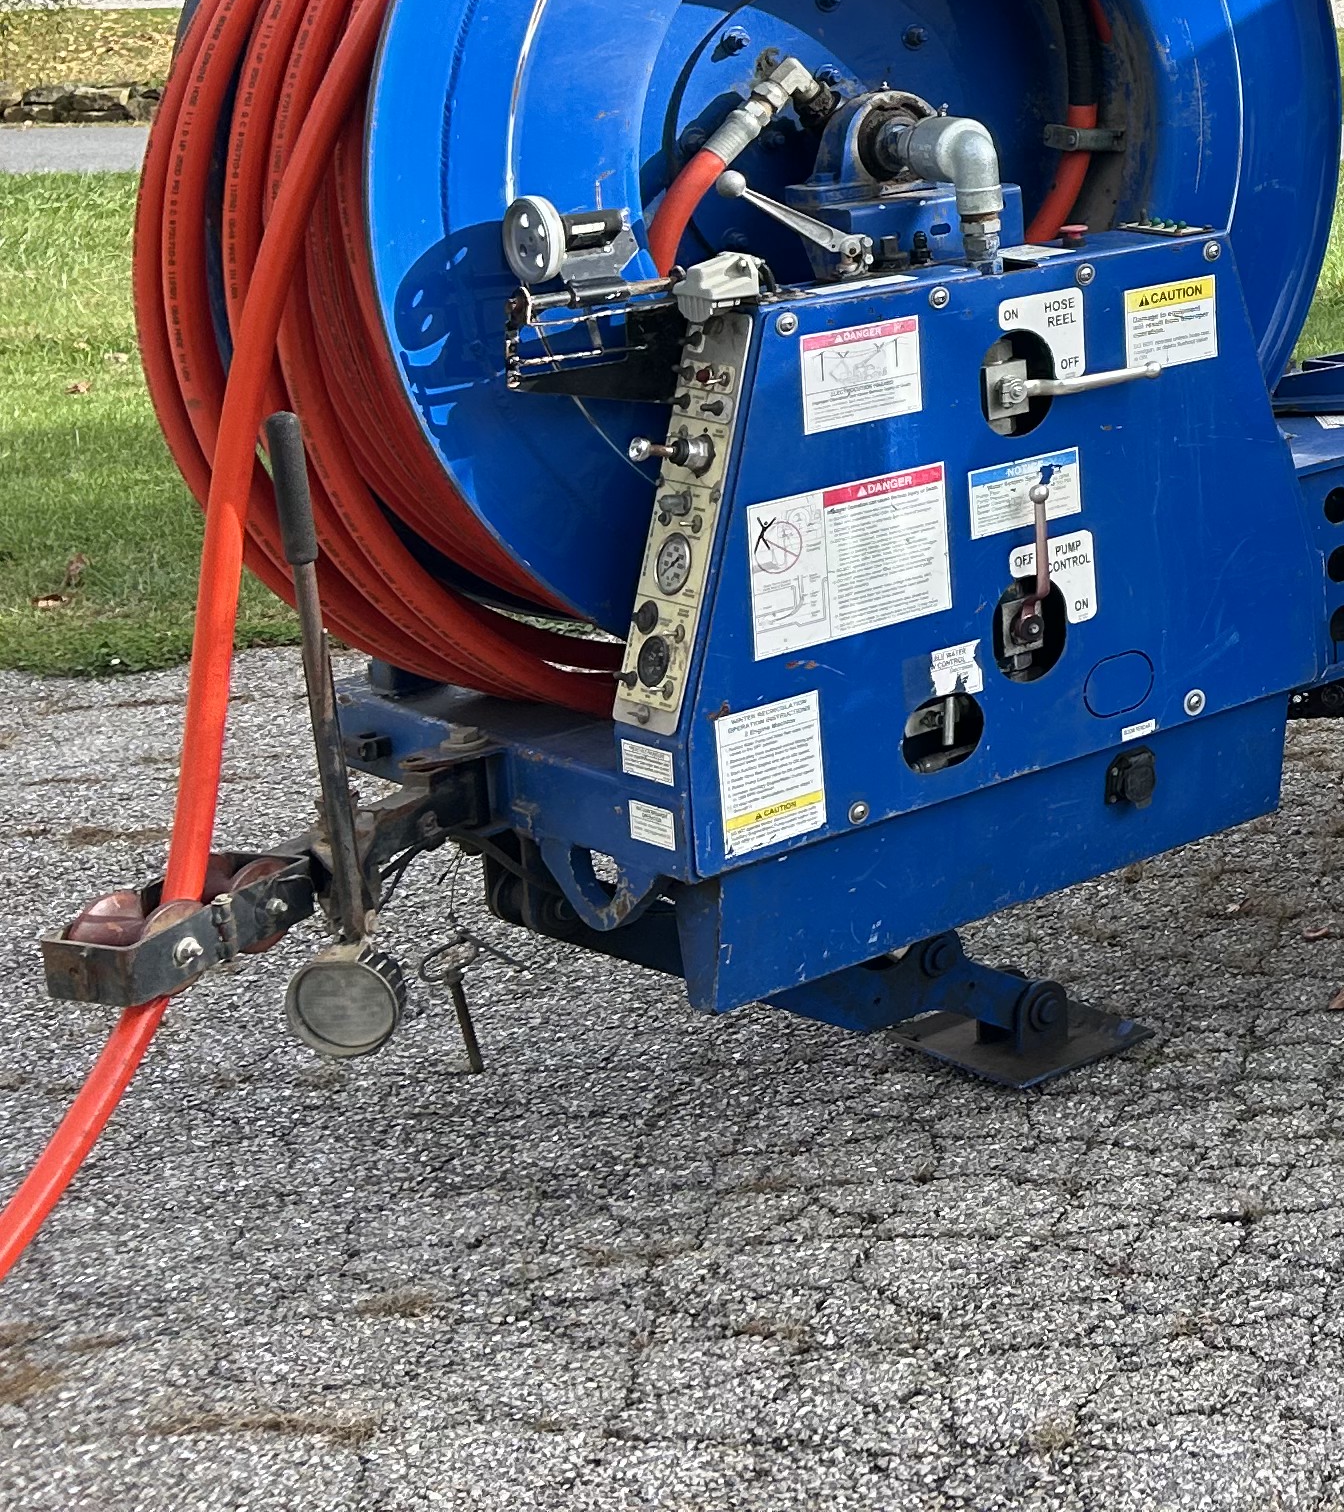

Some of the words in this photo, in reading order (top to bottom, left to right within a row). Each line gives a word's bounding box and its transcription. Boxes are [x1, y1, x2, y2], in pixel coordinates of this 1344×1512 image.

[187, 84, 201, 107] HOSE
[1150, 284, 1203, 305] CAUTION
[1044, 297, 1076, 314] HOSE
[1003, 308, 1019, 322] ON
[1047, 312, 1076, 328] REEL
[842, 328, 882, 341] DANGER
[1060, 356, 1080, 371] OFF
[867, 476, 913, 494] DANGER
[1055, 540, 1081, 556] PUMP
[1014, 553, 1034, 568] OFF
[1048, 555, 1091, 574] CONTROL
[1075, 598, 1089, 612] ON
[937, 657, 966, 668] CONTROL
[763, 801, 798, 818] CAUTION
